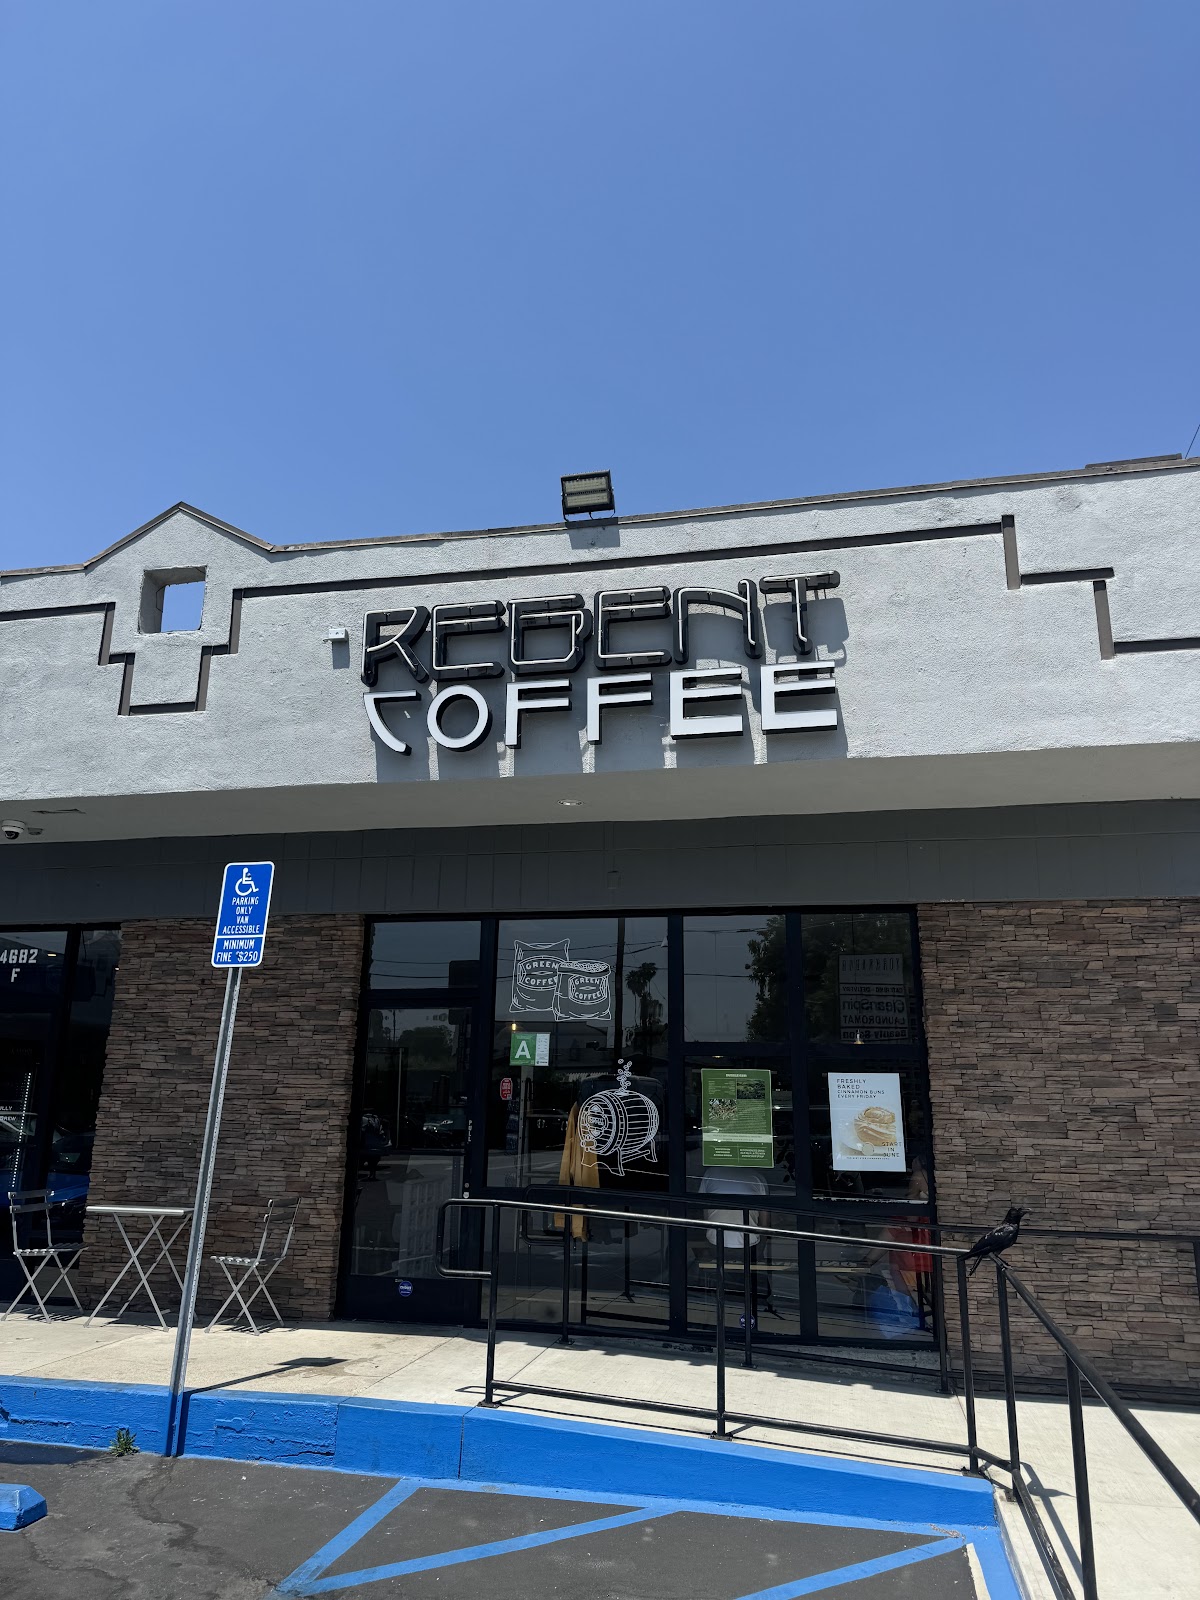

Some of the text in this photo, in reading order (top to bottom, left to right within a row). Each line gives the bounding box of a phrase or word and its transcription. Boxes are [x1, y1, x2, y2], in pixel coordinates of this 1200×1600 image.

[363, 660, 838, 755] COFFEE
[232, 896, 260, 906] PARKING
[235, 906, 253, 915] ONLY
[236, 916, 249, 924] VAN
[222, 925, 260, 934] ACCESSIBLE
[223, 939, 256, 950] MINIMUM
[0, 948, 39, 964] 4682
[216, 950, 259, 963] FINE $250
[525, 961, 558, 970] GREEN
[10, 967, 21, 983] F
[574, 976, 601, 985] GREEN
[574, 990, 602, 1000] COFFEE
[514, 1040, 531, 1059] A
